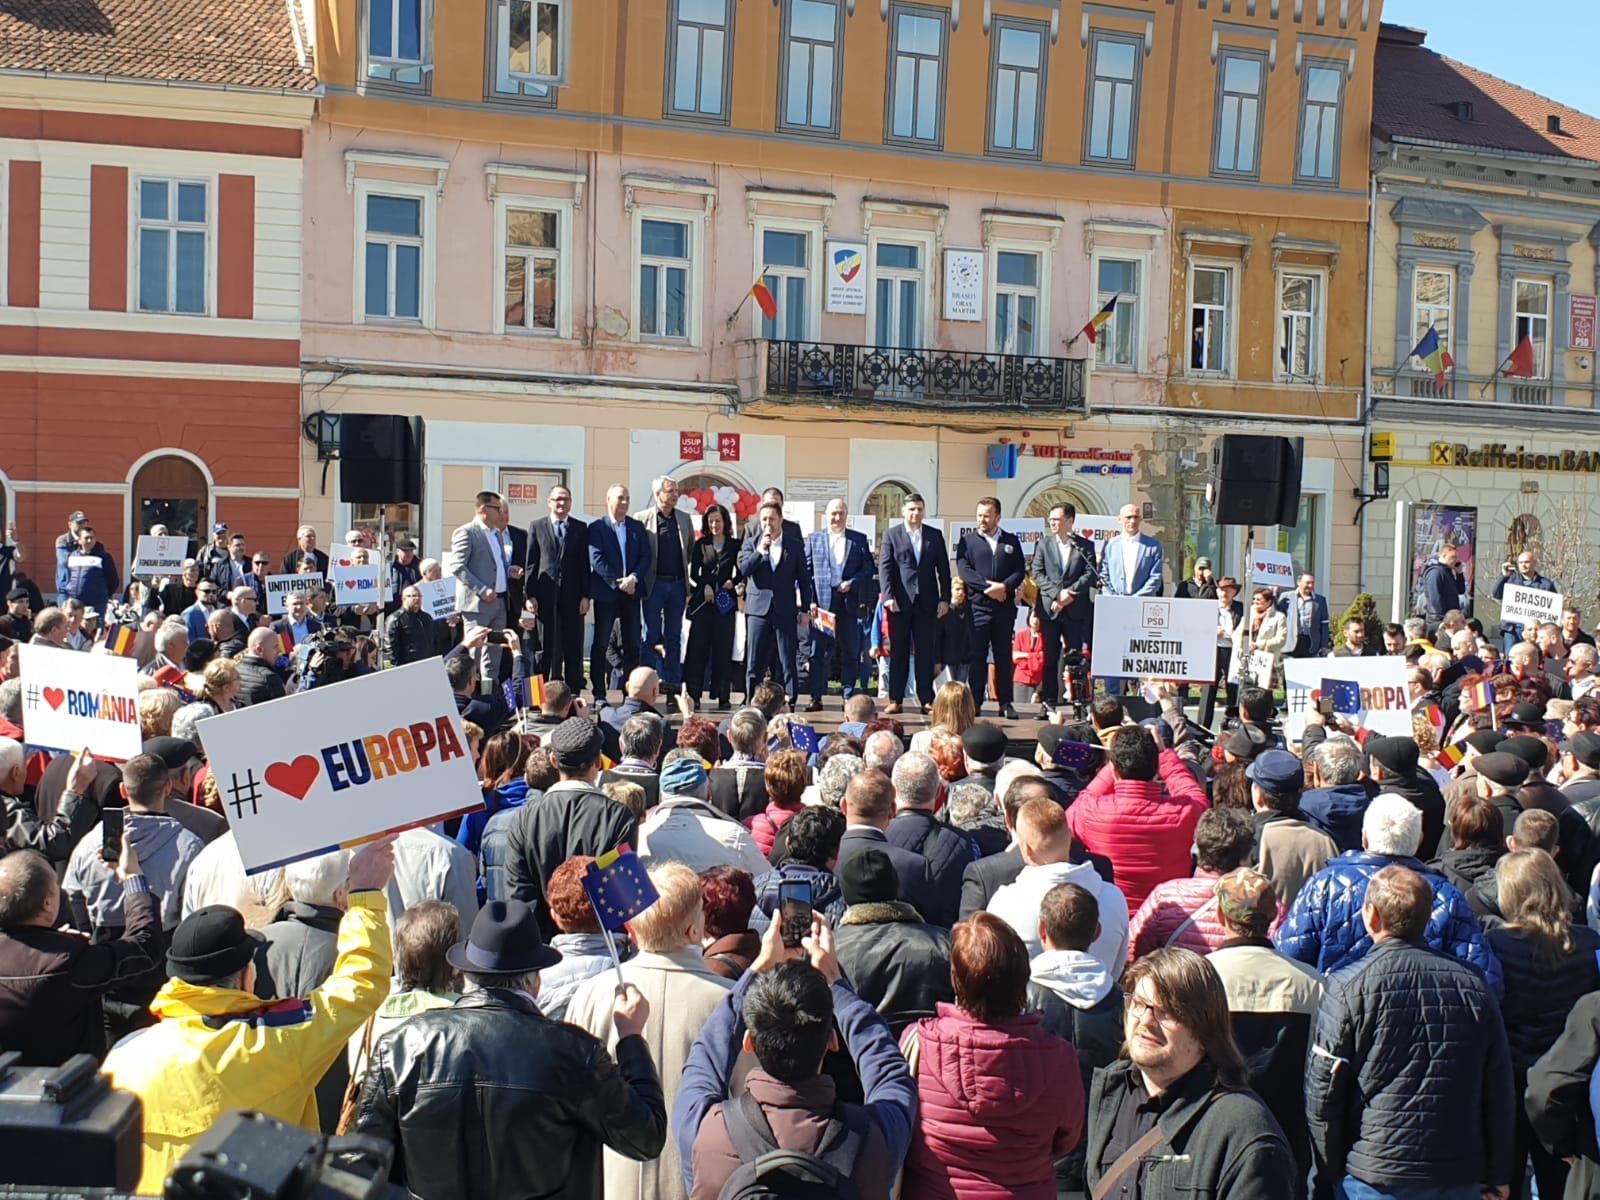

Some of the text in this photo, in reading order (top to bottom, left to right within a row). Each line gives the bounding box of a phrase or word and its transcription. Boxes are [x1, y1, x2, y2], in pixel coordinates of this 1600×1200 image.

[1575, 337, 1589, 347] PSD
[681, 438, 702, 447] USUP
[1094, 529, 1120, 541] EUROP
[1267, 563, 1292, 577] EUROPA
[1515, 591, 1553, 609] BRASOV
[1147, 617, 1164, 626] PSD
[1360, 686, 1408, 711] ROPA
[320, 715, 465, 792] EUROPA
